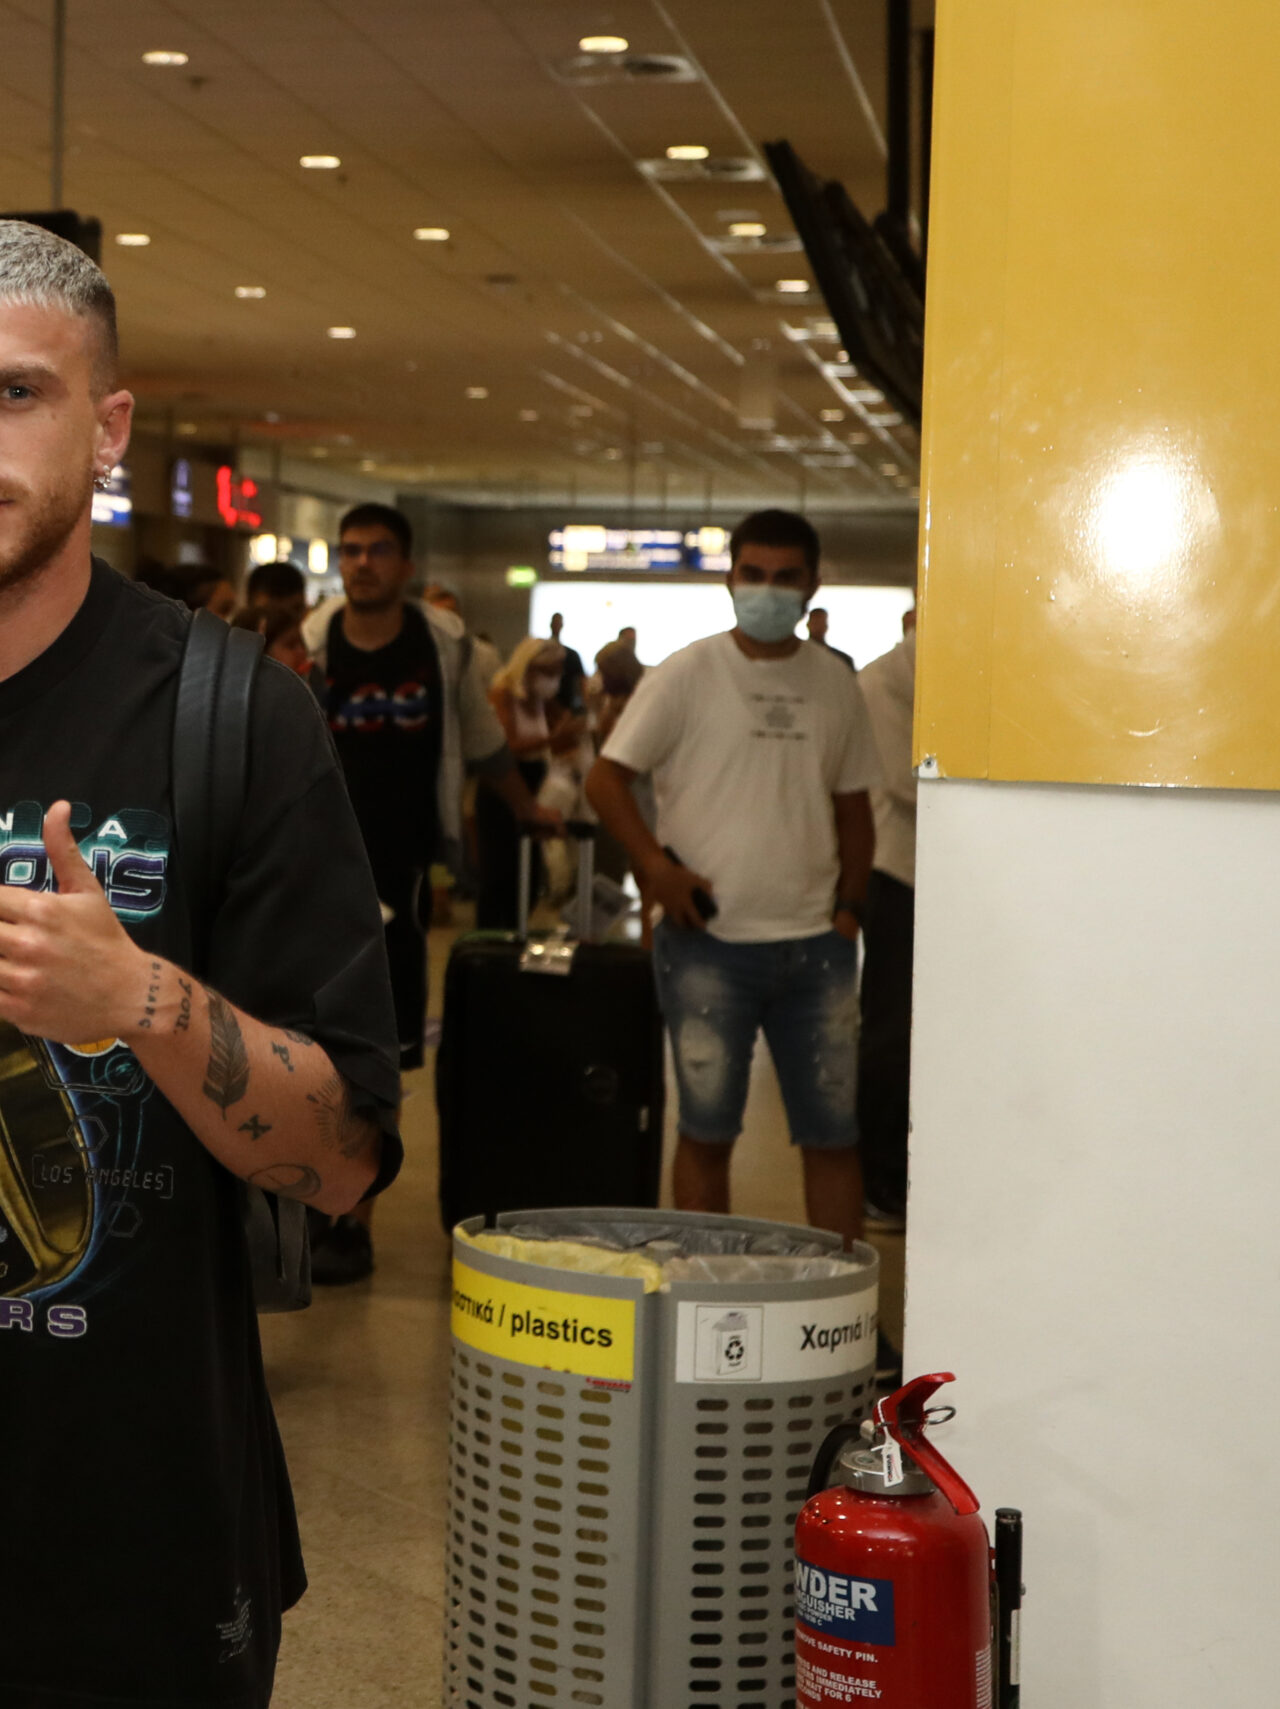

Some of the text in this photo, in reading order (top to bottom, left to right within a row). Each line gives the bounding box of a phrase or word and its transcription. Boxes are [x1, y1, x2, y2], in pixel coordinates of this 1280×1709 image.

[40, 1163, 165, 1191] LOS ANGELES
[511, 1310, 613, 1347] plastics
[794, 1560, 878, 1612] WDER
[817, 1641, 853, 1659] SAFETY
[855, 1651, 878, 1663] PIN.
[815, 1675, 883, 1699] IMMEDIATELY
[829, 1672, 877, 1690] RELEASE
[824, 1687, 843, 1700] FOR
